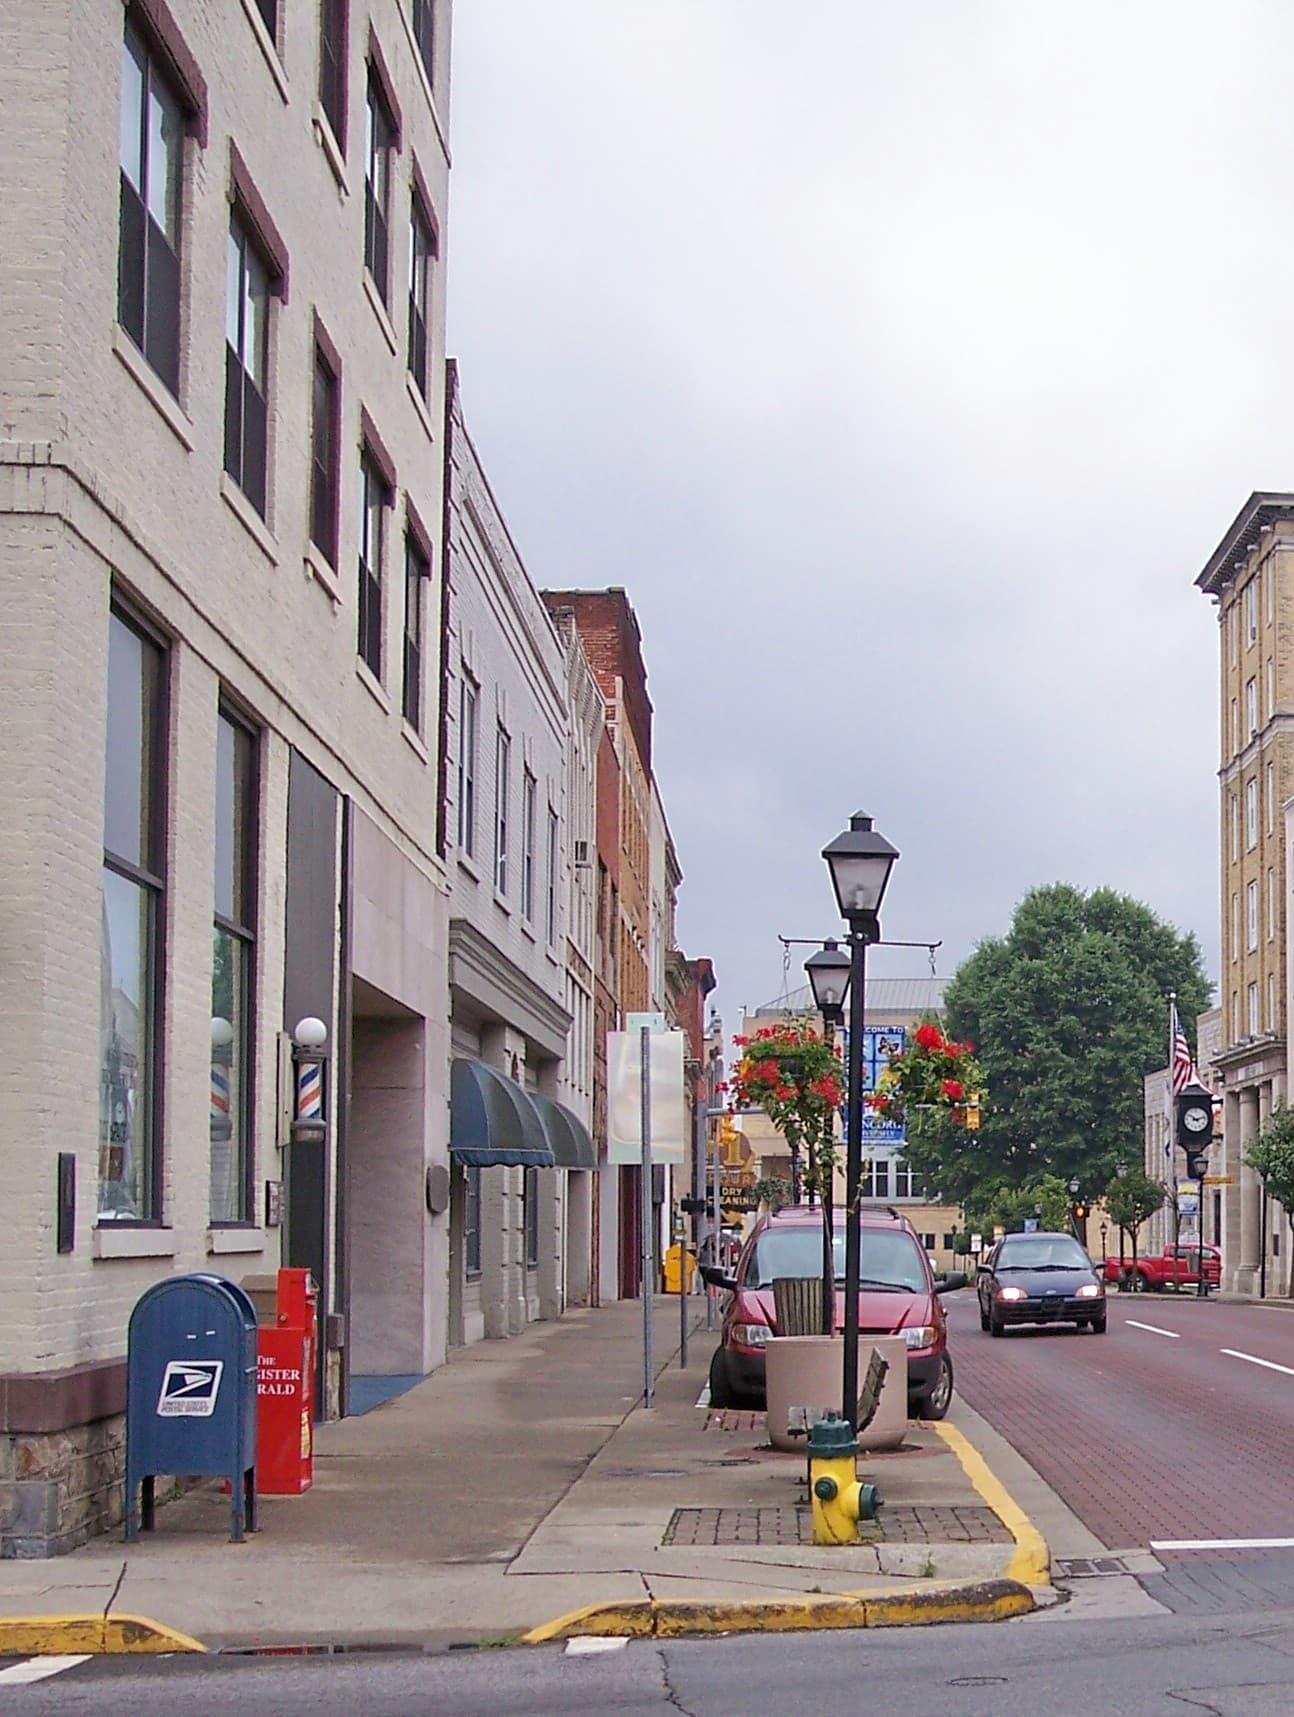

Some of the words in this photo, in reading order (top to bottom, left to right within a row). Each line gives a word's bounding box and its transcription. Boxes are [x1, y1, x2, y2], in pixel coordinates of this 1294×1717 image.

[892, 1025, 905, 1034] TO
[722, 1187, 743, 1196] DRY
[707, 1196, 757, 1206] CEANING
[257, 1369, 301, 1380] ISTER
[257, 1384, 296, 1395] RALD
